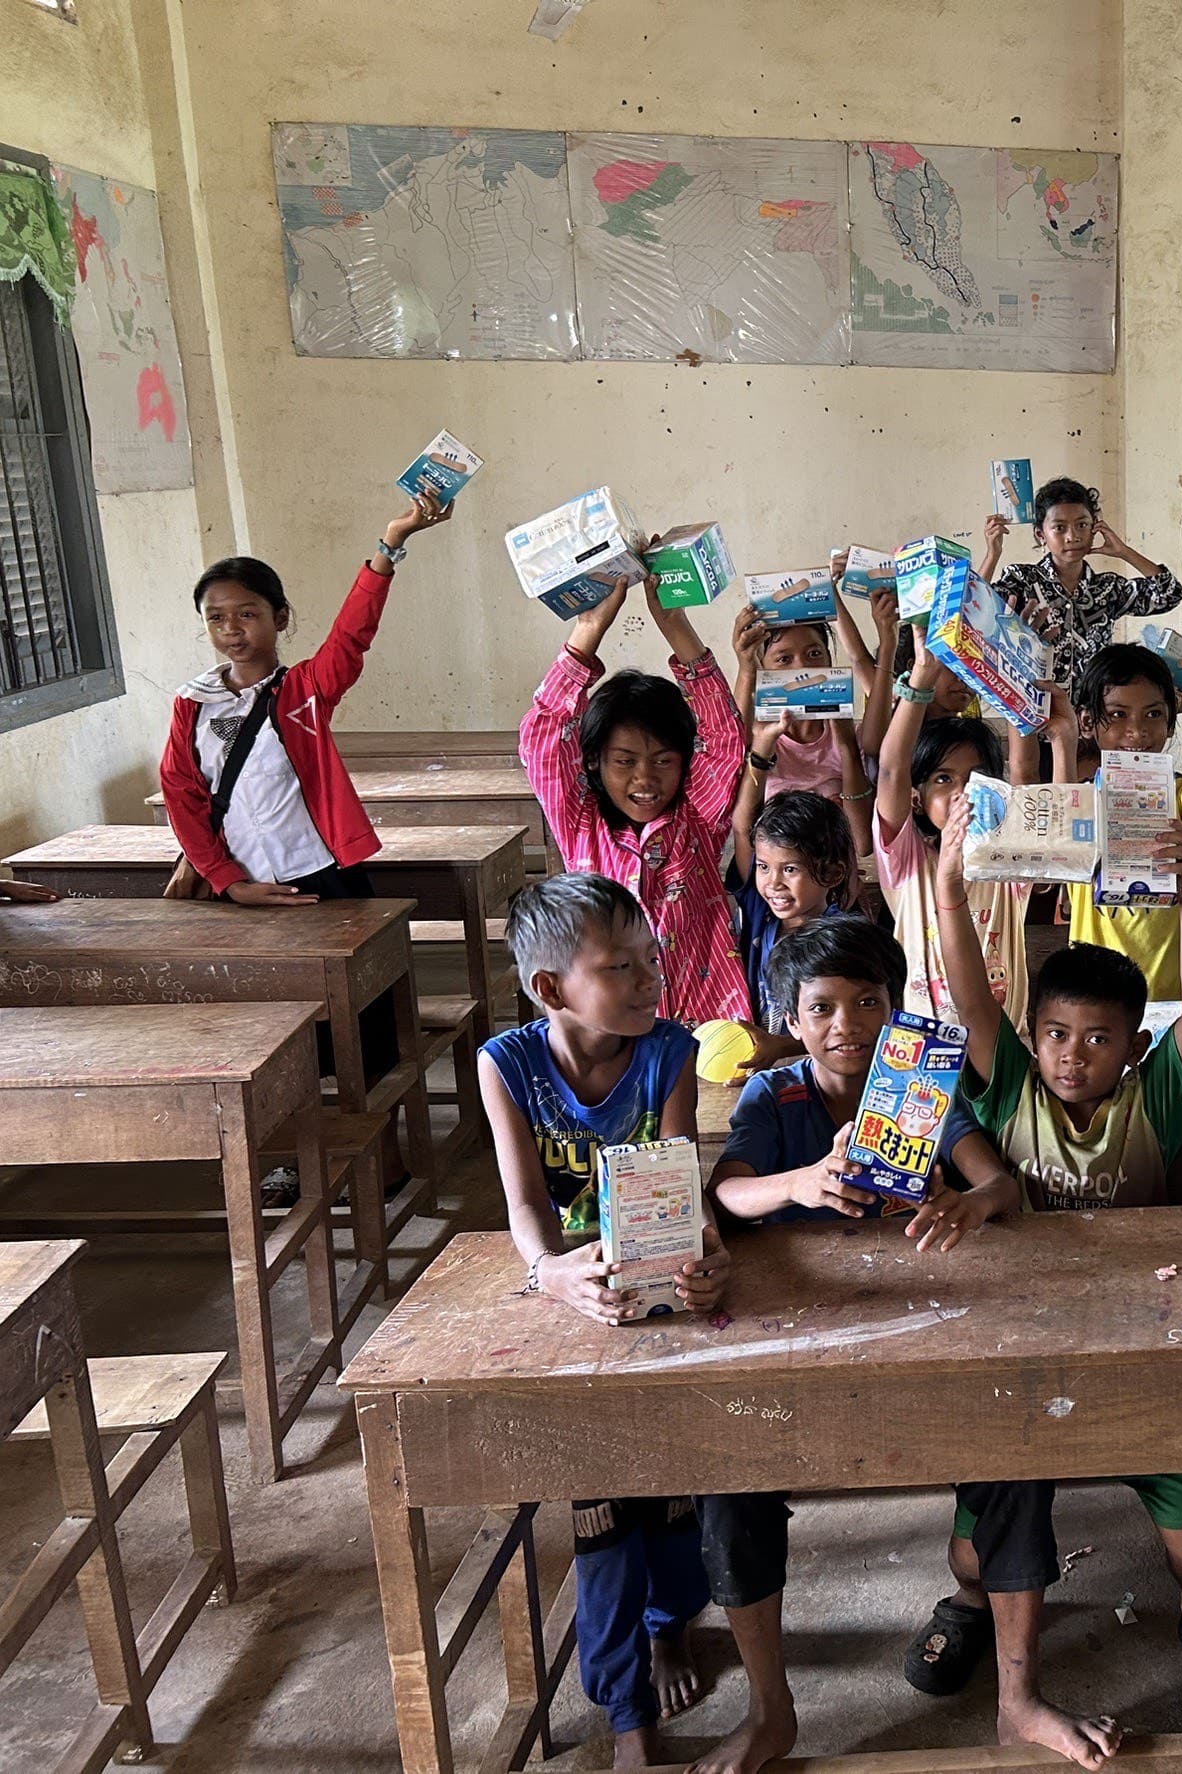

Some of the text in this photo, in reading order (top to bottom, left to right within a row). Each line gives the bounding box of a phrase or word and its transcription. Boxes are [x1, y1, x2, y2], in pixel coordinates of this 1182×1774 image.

[897, 551, 936, 574] サロンパス
[1024, 796, 1037, 832] 100%
[1038, 788, 1053, 837] Cotton
[882, 1040, 925, 1065] No.1
[857, 1115, 929, 1170] 熱さまシート
[1047, 1194, 1070, 1208] THE
